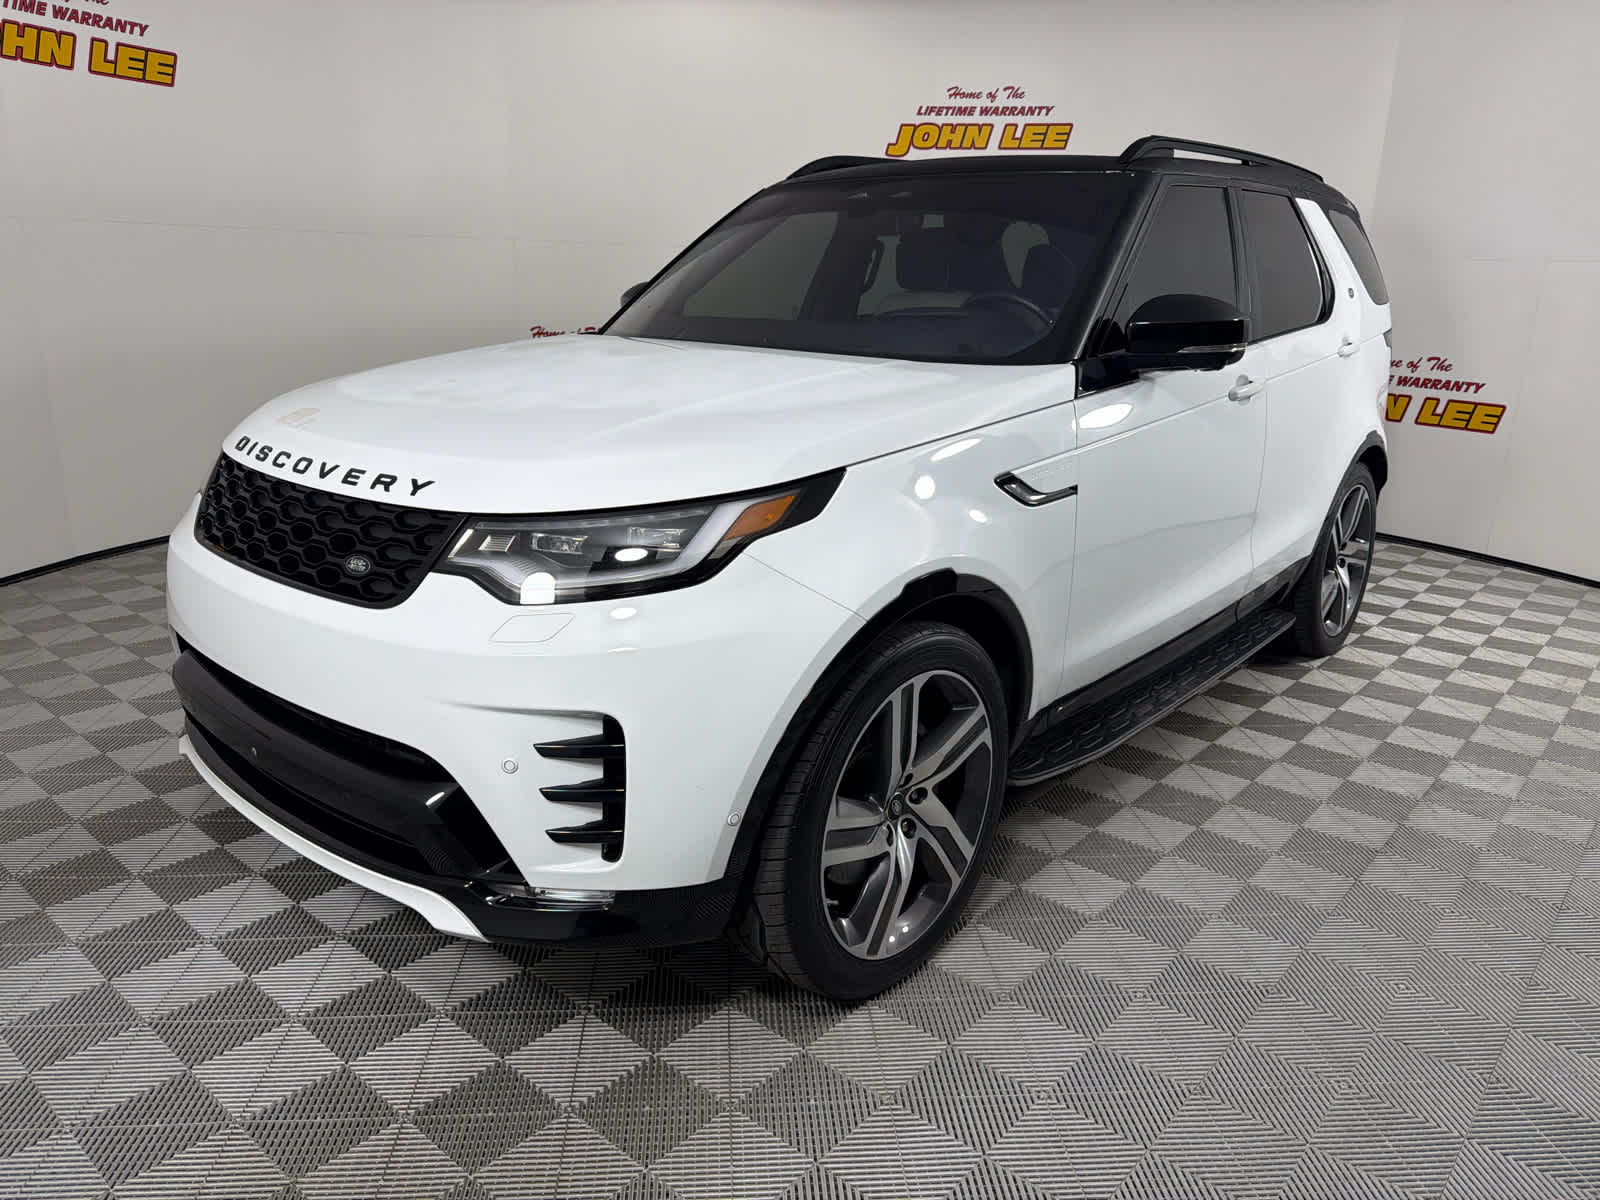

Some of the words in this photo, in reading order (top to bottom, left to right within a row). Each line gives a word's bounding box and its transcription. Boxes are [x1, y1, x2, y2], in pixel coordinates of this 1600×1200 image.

[52, 4, 149, 37] WARRANTY
[0, 19, 76, 70] HN
[88, 37, 178, 88] LEE
[947, 86, 983, 100] Home
[985, 87, 999, 103] of
[1002, 86, 1025, 100] The
[916, 106, 976, 117] LIFETIME
[979, 106, 1055, 117] WARRANTY
[885, 122, 994, 157] JOHN
[998, 123, 1073, 150] LEE
[1406, 357, 1423, 373] of
[1427, 357, 1453, 372] The
[1396, 375, 1486, 394] WARRANTY
[1414, 397, 1507, 434] LEE
[235, 435, 435, 497] DISCOVERY
